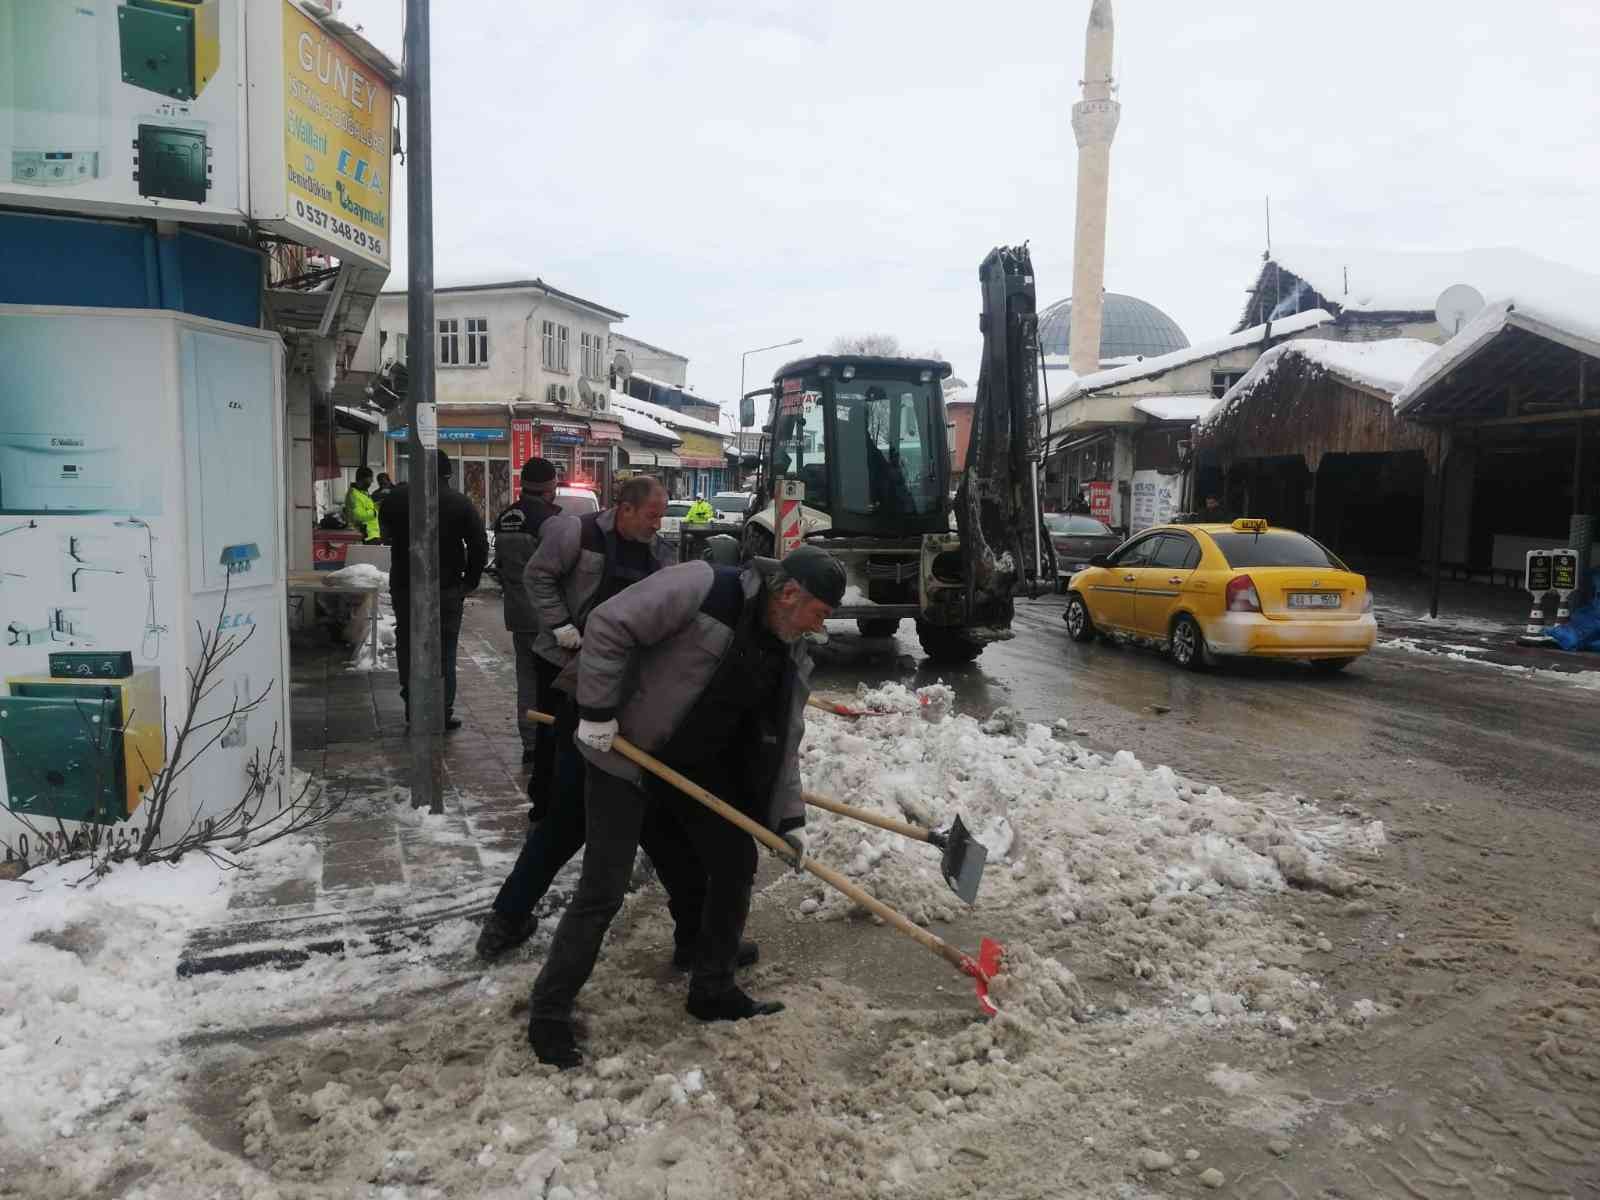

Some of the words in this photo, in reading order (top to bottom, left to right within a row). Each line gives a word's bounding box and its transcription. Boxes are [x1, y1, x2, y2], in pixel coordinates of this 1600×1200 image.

[298, 32, 378, 113] GÜNEY
[296, 200, 305, 218] 0
[305, 205, 328, 229] 537
[330, 217, 352, 241] 348
[353, 228, 366, 247] 29
[368, 236, 382, 254] 36
